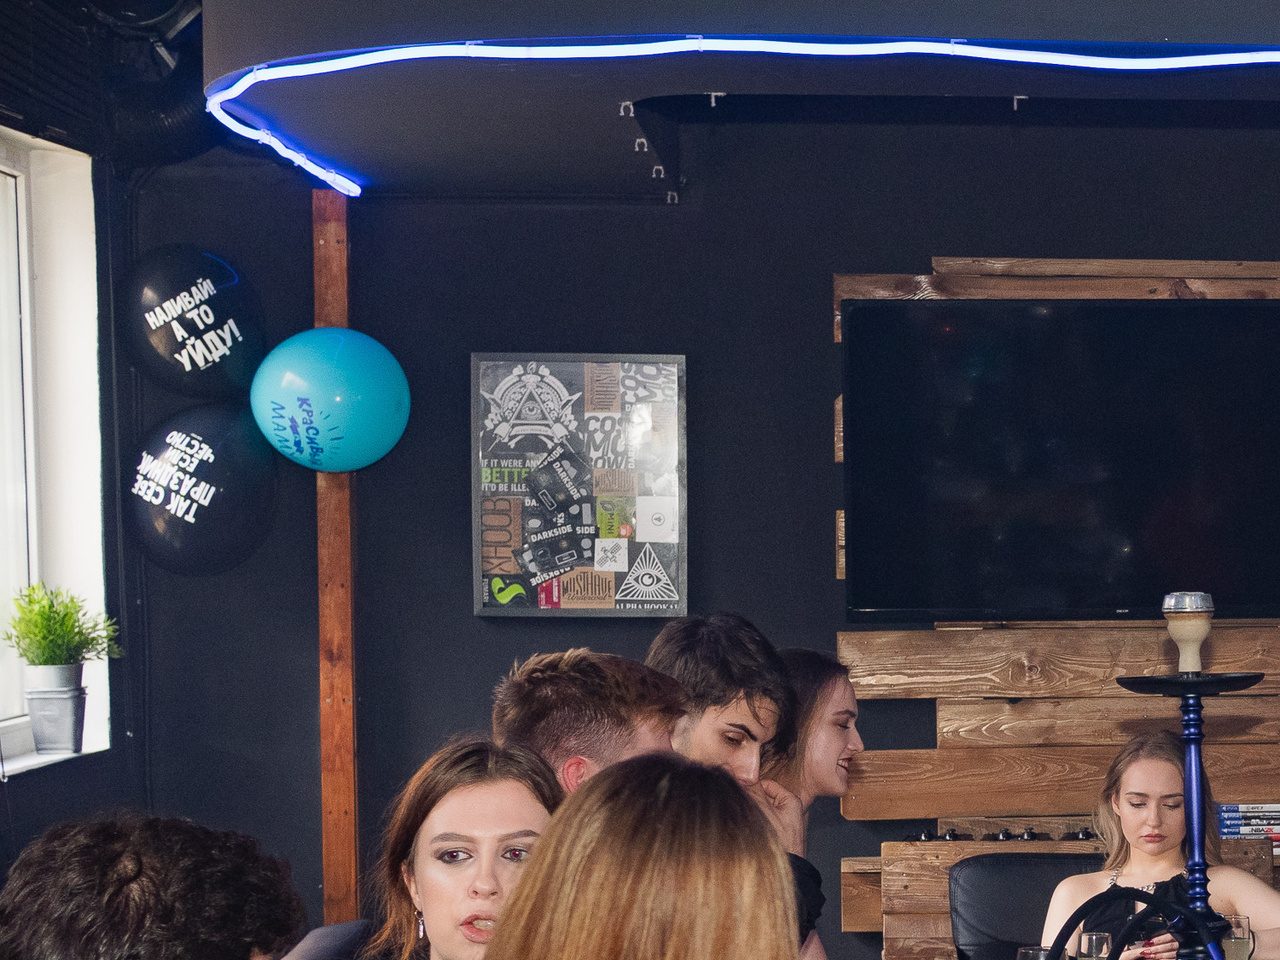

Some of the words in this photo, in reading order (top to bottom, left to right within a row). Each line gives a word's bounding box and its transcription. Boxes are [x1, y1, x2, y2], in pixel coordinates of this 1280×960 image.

[145, 278, 217, 330] НАЛИВАЙ!
[171, 320, 189, 342] А
[186, 304, 215, 330] ТО
[174, 318, 243, 372] УЙДУ!
[163, 446, 200, 473] ЕСЛИ
[165, 430, 215, 463] ЧЕСТНО
[481, 459, 488, 468] IF
[490, 459, 499, 468] IT
[502, 459, 523, 468] WERE
[481, 467, 534, 483] BETTE
[131, 474, 165, 505] СЕБЕ
[498, 483, 510, 492] BE
[511, 483, 530, 492] ILLE
[552, 460, 581, 501] DARKSIDE
[165, 492, 199, 524] ТАК
[530, 524, 574, 543] DARKSIDE
